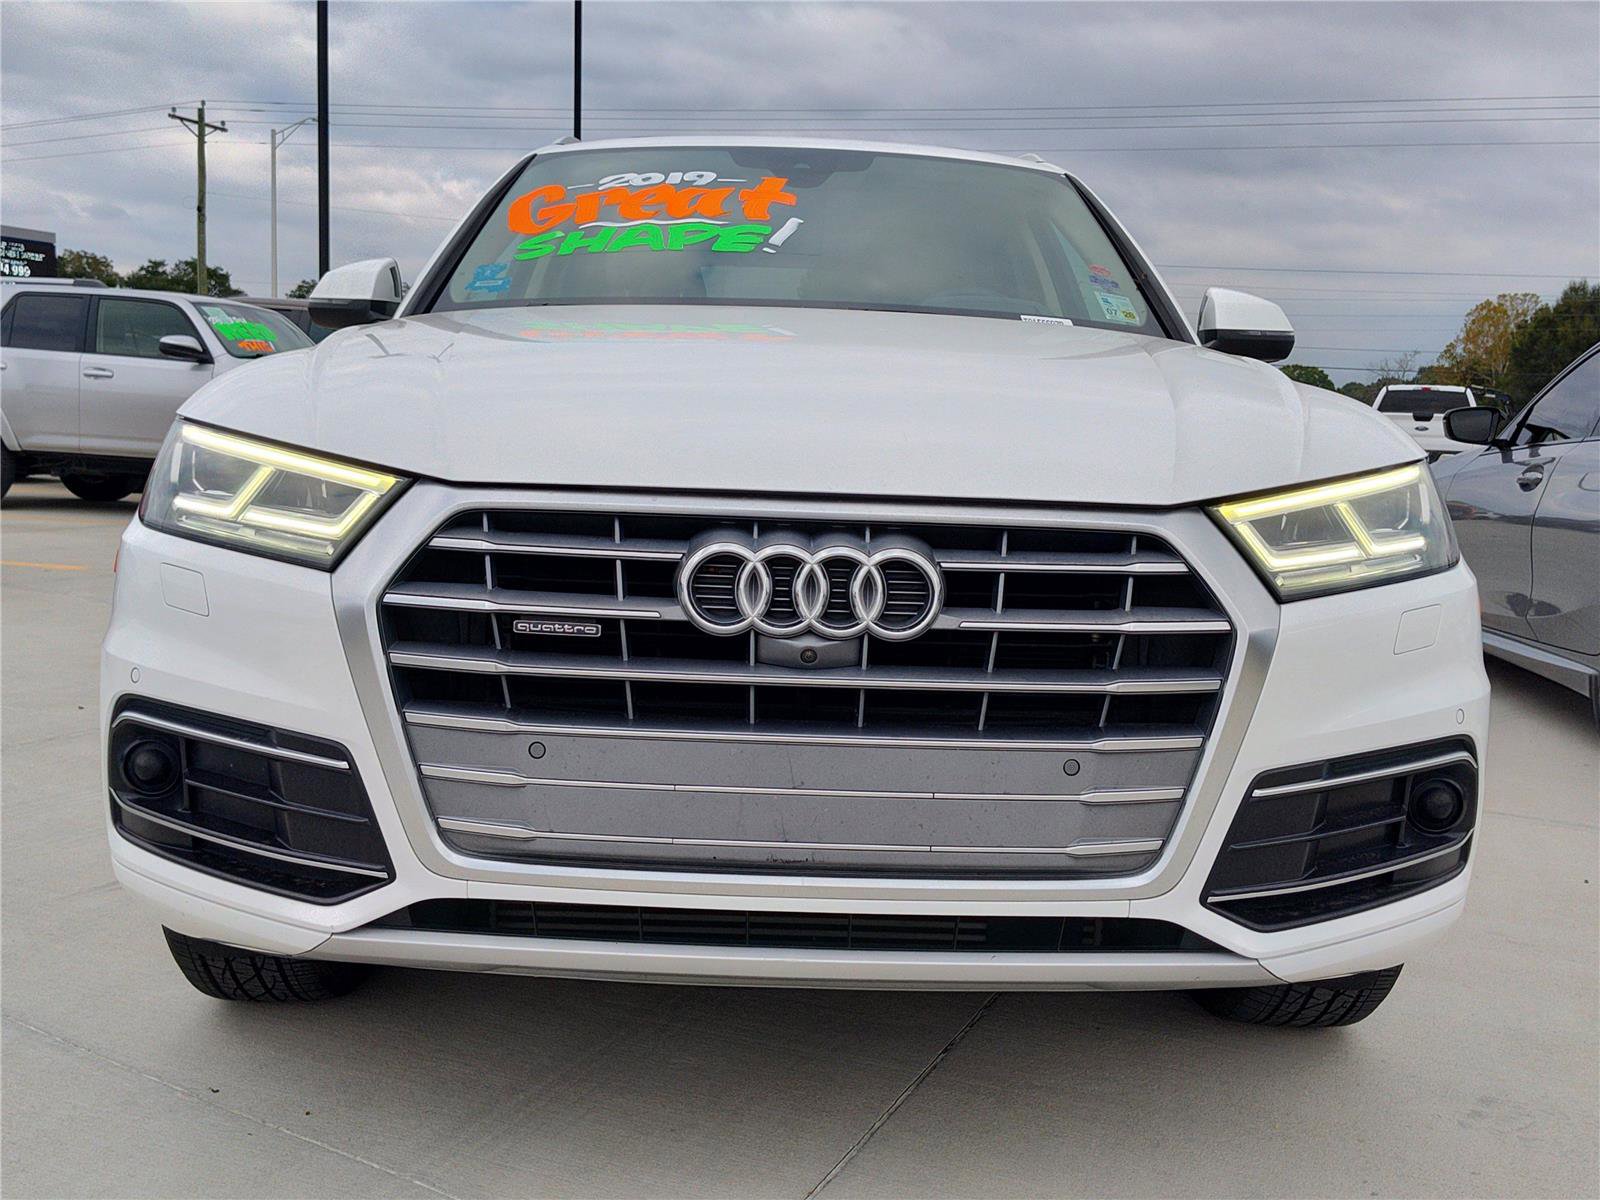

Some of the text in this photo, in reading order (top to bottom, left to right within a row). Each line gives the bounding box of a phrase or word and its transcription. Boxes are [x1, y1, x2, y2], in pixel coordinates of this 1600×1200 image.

[598, 171, 718, 190] 2019
[507, 176, 798, 236] Great
[513, 217, 804, 261] SHAPE!
[517, 623, 597, 634] quattro
